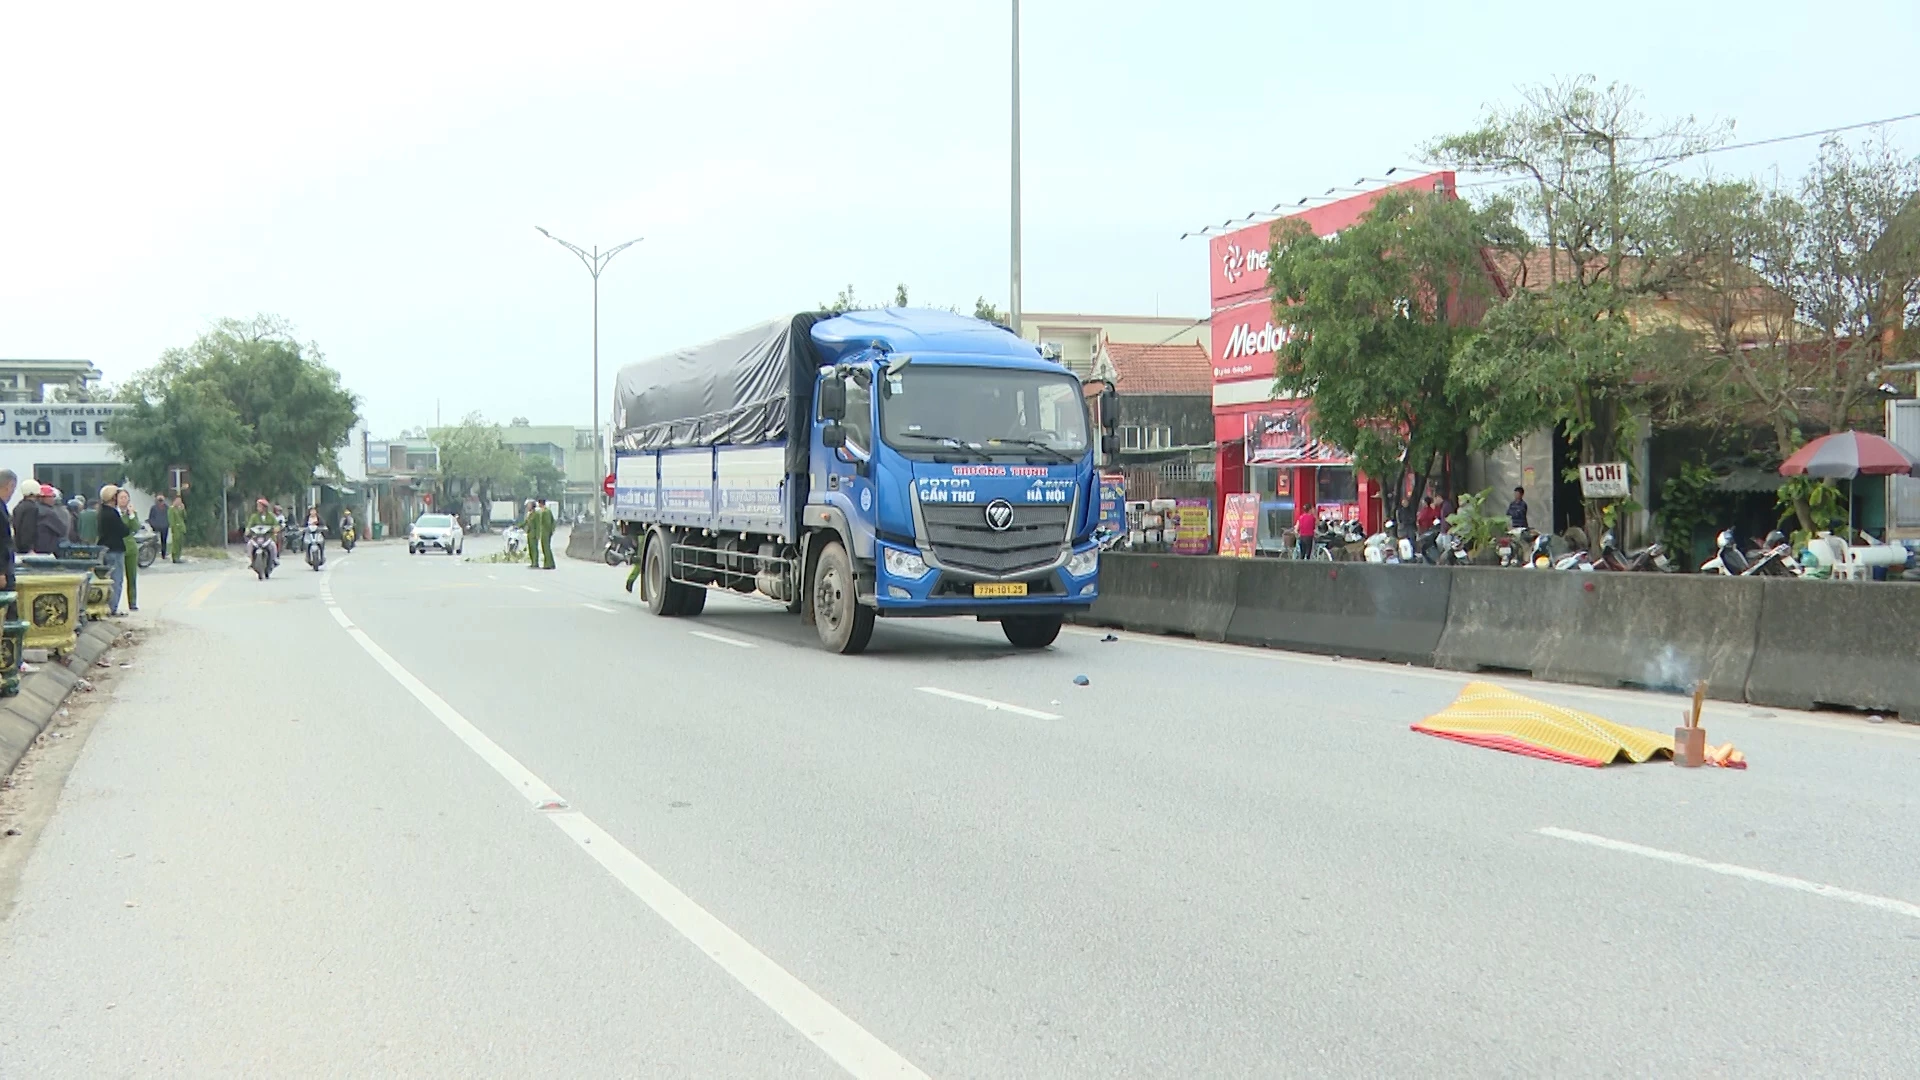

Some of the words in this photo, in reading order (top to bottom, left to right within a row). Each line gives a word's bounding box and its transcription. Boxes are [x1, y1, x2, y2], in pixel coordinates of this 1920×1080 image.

[919, 479, 970, 488] FOTON
[920, 486, 948, 502] CẦN
[951, 489, 976, 502] THƠ
[1026, 487, 1043, 502] HÀ
[1045, 488, 1066, 504] NỘI
